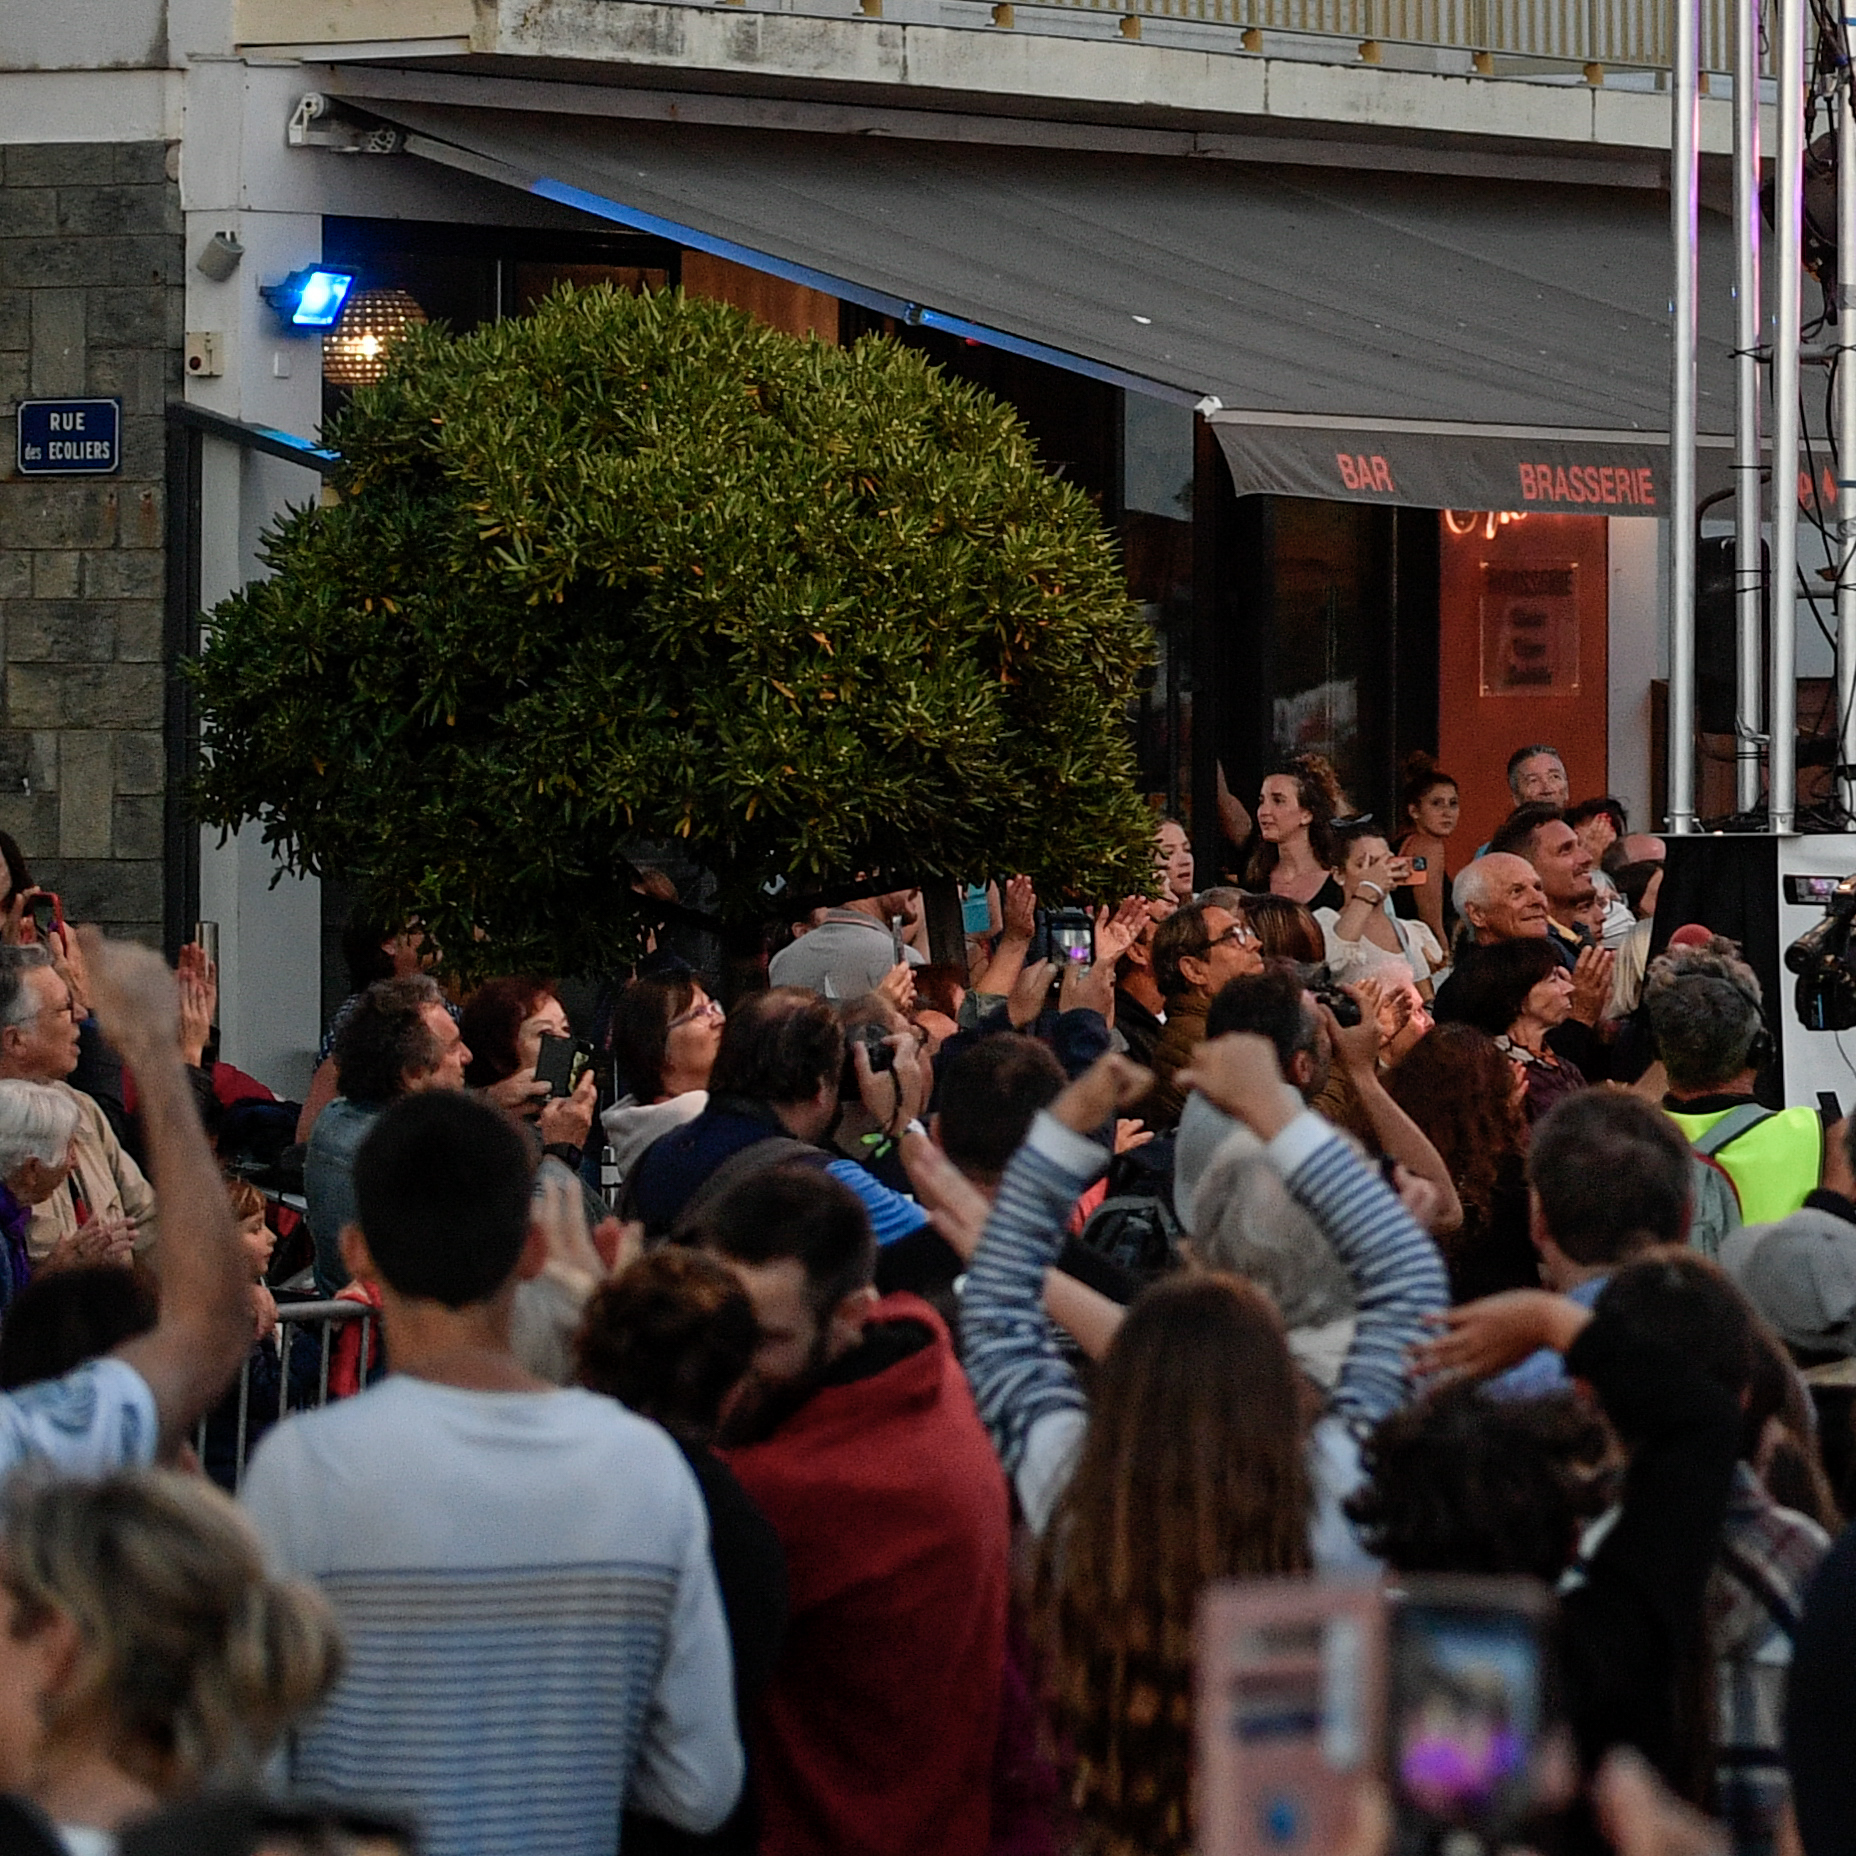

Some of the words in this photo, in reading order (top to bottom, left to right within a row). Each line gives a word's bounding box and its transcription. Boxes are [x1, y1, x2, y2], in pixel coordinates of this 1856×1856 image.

[49, 412, 86, 432] RUE
[24, 443, 42, 461] des
[48, 440, 111, 461] ECOLIERS
[1336, 453, 1395, 492] BAR
[1518, 462, 1656, 505] BRASSERIE
